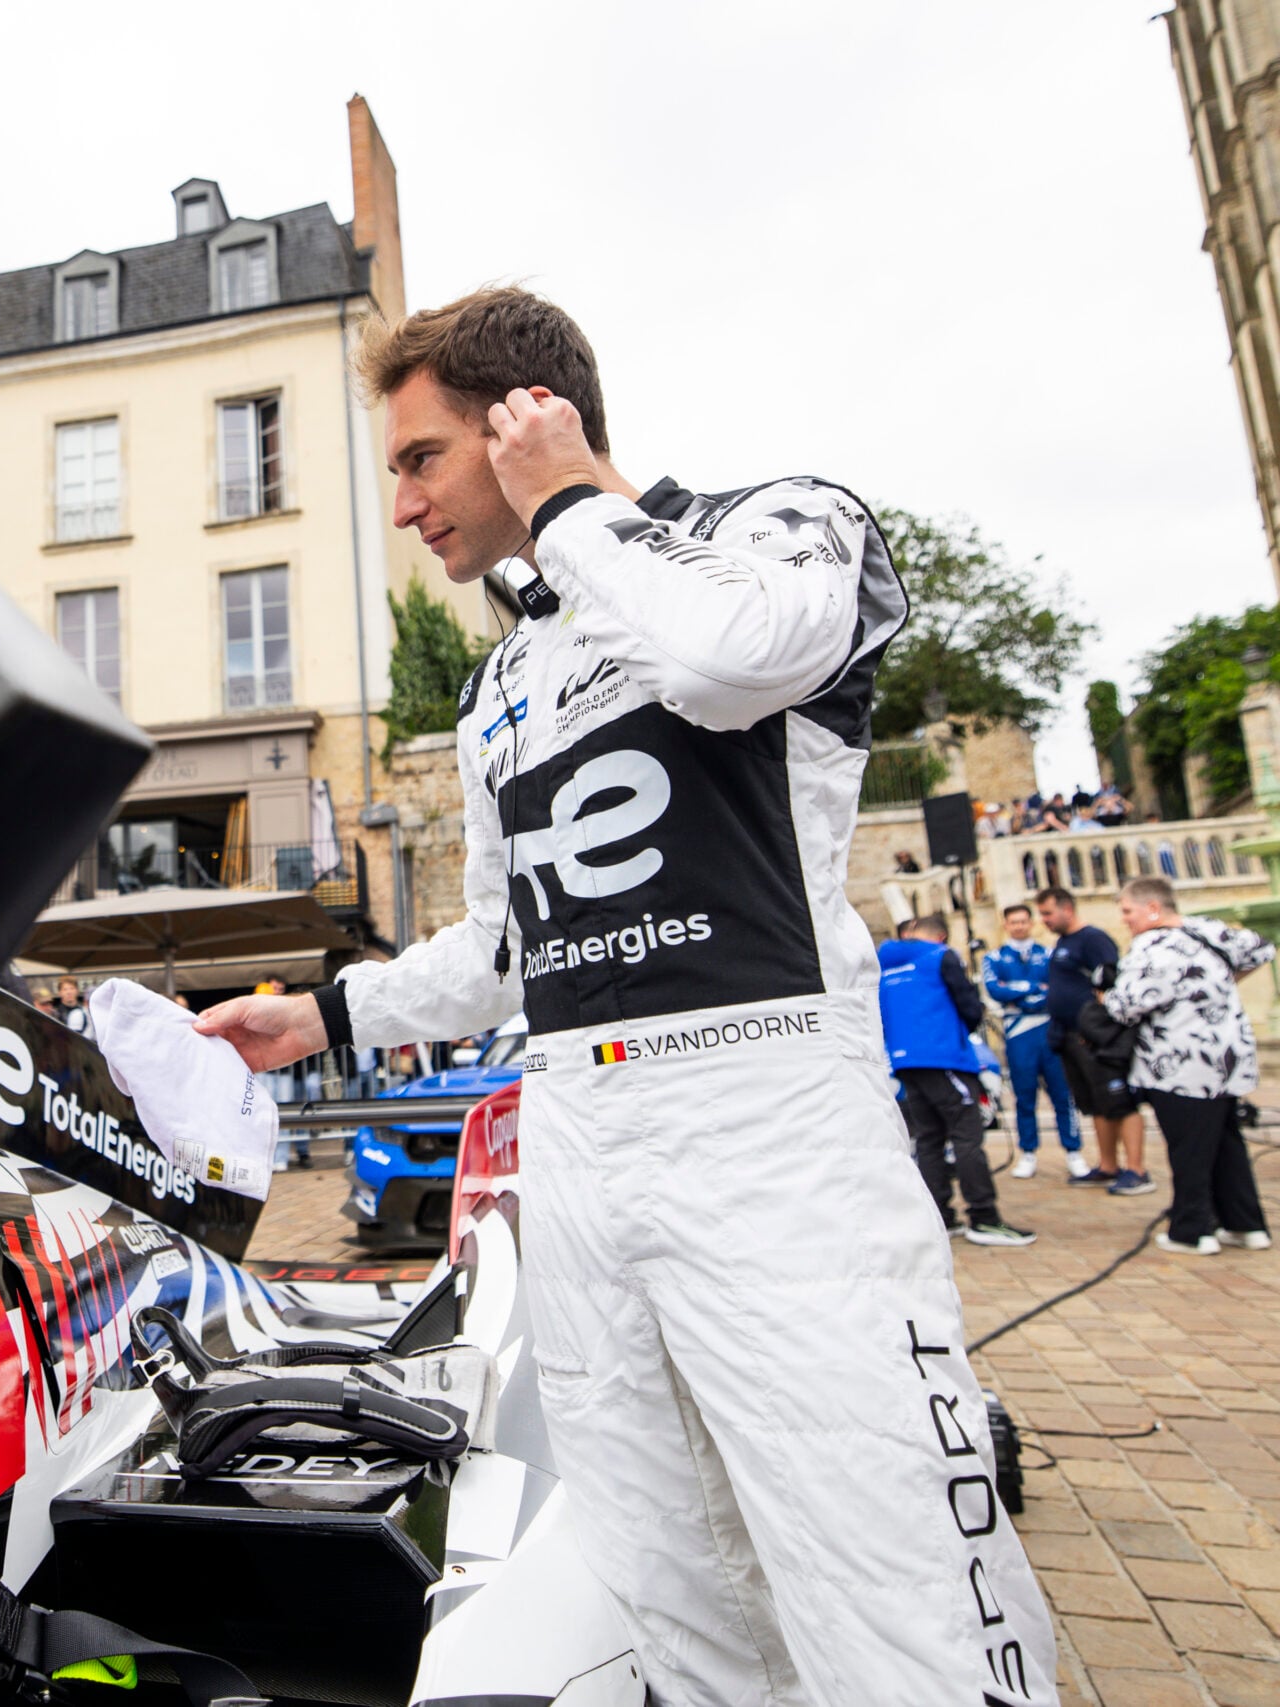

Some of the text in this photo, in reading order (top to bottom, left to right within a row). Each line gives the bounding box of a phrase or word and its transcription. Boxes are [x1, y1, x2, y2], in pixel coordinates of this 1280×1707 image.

[568, 693, 600, 716] WORLD
[626, 1010, 822, 1060] S.VANDOORNE
[38, 1073, 196, 1205] TotalEnergies
